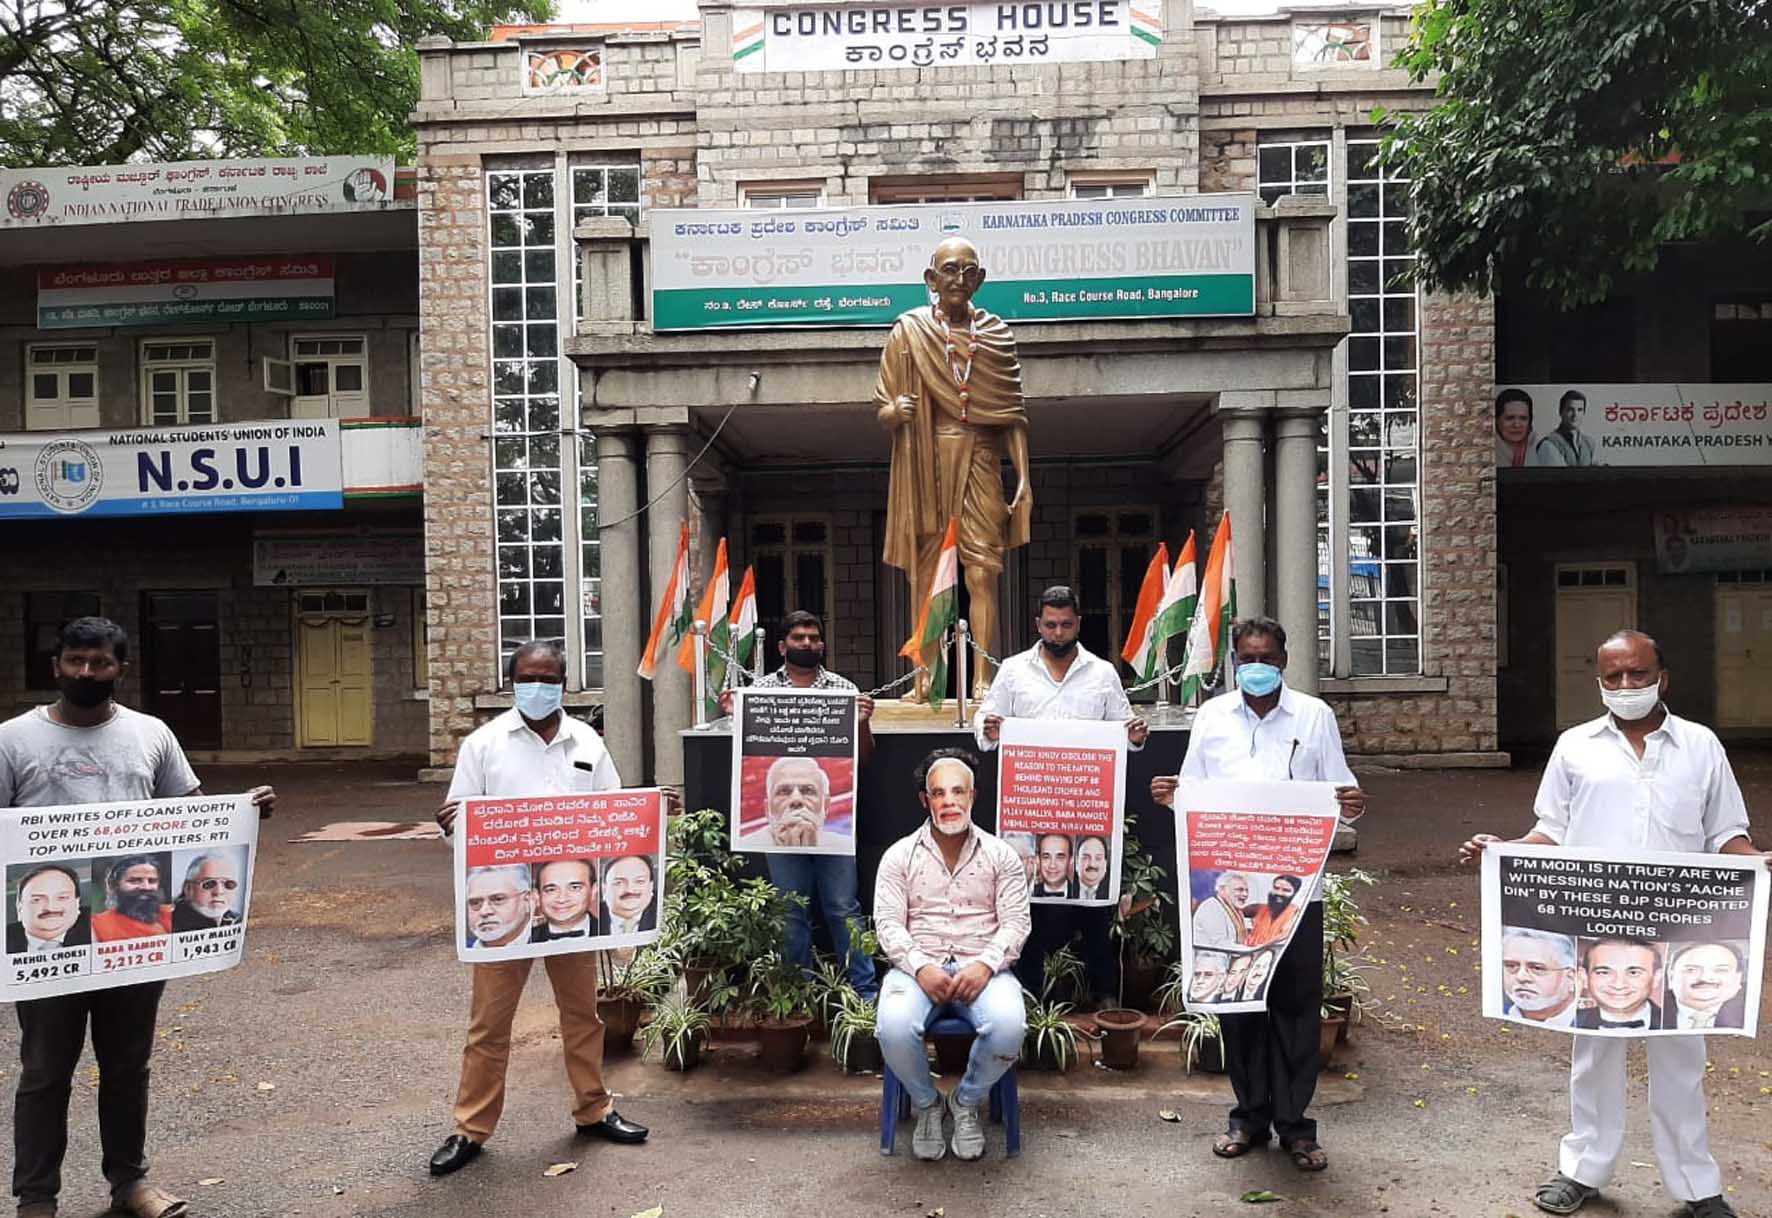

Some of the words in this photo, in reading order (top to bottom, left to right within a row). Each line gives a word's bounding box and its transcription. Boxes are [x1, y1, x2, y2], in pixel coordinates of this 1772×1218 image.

[773, 7, 967, 36] CONGRESS
[997, 1, 1119, 30] HOUSE
[845, 37, 965, 66] ಕಾಂಗ್ರೆಸ್
[976, 34, 1049, 62] ಭವನ
[64, 204, 109, 217] INDIAN
[110, 200, 168, 216] NATIONAL
[175, 197, 214, 212] TRADE
[219, 197, 258, 210] UNION
[261, 193, 329, 209] CONGRESS
[674, 222, 743, 236] ಕರ್ನಾಟಕ
[751, 217, 796, 239] ಪ್ರದೇಶ
[805, 216, 868, 237] ಕಾಂಗ್ರೆಸ್
[876, 217, 920, 231] ಸಮಿತಿ
[982, 214, 1048, 229] KARNATAKA
[1051, 212, 1104, 227] PRADESH
[1106, 209, 1167, 225] CONGRESS
[1170, 207, 1240, 223] COMMITTEE
[1023, 292, 1049, 305] No.3,
[1051, 291, 1077, 302] Race
[1080, 290, 1114, 302] Course
[1116, 289, 1145, 303] Road,
[1148, 287, 1199, 302] Bangalore
[1604, 401, 1695, 423] ಕರ್ನಾಟಕ
[1703, 400, 1768, 429] ಪ್ರದೇಶ
[109, 433, 167, 446] NATIONAL
[169, 429, 231, 443] STUDENTS'
[233, 428, 272, 441] UNION
[275, 427, 290, 440] OF
[292, 426, 326, 439] INDIA
[1601, 435, 1692, 448] KARNATAKA
[1695, 433, 1763, 447] PRADESH
[137, 446, 302, 493] N.S.U.I
[182, 498, 212, 509] Course
[1060, 751, 1097, 761] DISCLOSE
[1098, 753, 1113, 762] THE
[1014, 762, 1045, 771] REASON
[1046, 763, 1057, 771] TO
[1057, 764, 1072, 772] THE
[1015, 773, 1043, 783] BEHIND
[1044, 774, 1073, 784] WAVING
[1074, 776, 1090, 785] OFF
[1013, 784, 1053, 794] THOUSAND
[1054, 786, 1084, 796] CRORES
[1085, 788, 1101, 797] AND
[592, 799, 608, 809] 68
[1003, 795, 1060, 807] SAFEGUARDING
[1060, 798, 1075, 808] THE
[1076, 799, 1110, 809] LOOTERS
[20, 815, 44, 826] RBI
[48, 811, 101, 825] WRITES
[105, 809, 133, 820] OFF
[136, 806, 183, 818] LOANS
[187, 802, 236, 815] WORTH
[1055, 809, 1075, 818] BABA
[28, 829, 69, 841] OVER
[73, 827, 90, 838] RS
[93, 824, 139, 837] 68,607
[142, 820, 188, 833] CRORE
[191, 818, 210, 829] OF
[214, 816, 229, 827] 50
[28, 845, 58, 857] TOP
[62, 841, 113, 854] WILFUL
[117, 833, 206, 849] DEFAULTERS:
[210, 831, 229, 841] RTI
[1513, 858, 1537, 870] PM
[1588, 863, 1603, 873] IS
[1607, 863, 1623, 874] IT
[1625, 864, 1675, 879] TRUE?
[1678, 868, 1710, 880] ARE
[1714, 869, 1740, 882] WE
[1508, 872, 1604, 889] WITNESSING
[1608, 879, 1681, 893] NATION'S
[1538, 889, 1559, 900] BY
[1561, 890, 1612, 904] THESE
[1619, 895, 1650, 907] BJP
[1653, 896, 1749, 911] SUPPORTED
[1537, 903, 1556, 915] 68
[1560, 905, 1645, 921] THOUSAND
[1648, 911, 1713, 925] CRORES
[179, 933, 206, 944] VIJAY
[209, 927, 241, 939] MALLYA
[1586, 922, 1661, 938] LOOTERS.
[12, 954, 48, 966] MEHUL
[51, 948, 87, 960] CHOKSI
[98, 945, 125, 956] BABA
[128, 939, 168, 952] RAMDEV
[183, 943, 220, 959] 1,943
[223, 940, 237, 951] CR
[104, 954, 144, 970] 2,212
[148, 951, 164, 962] CR
[16, 965, 59, 981] 5,492
[63, 962, 80, 974] CR
